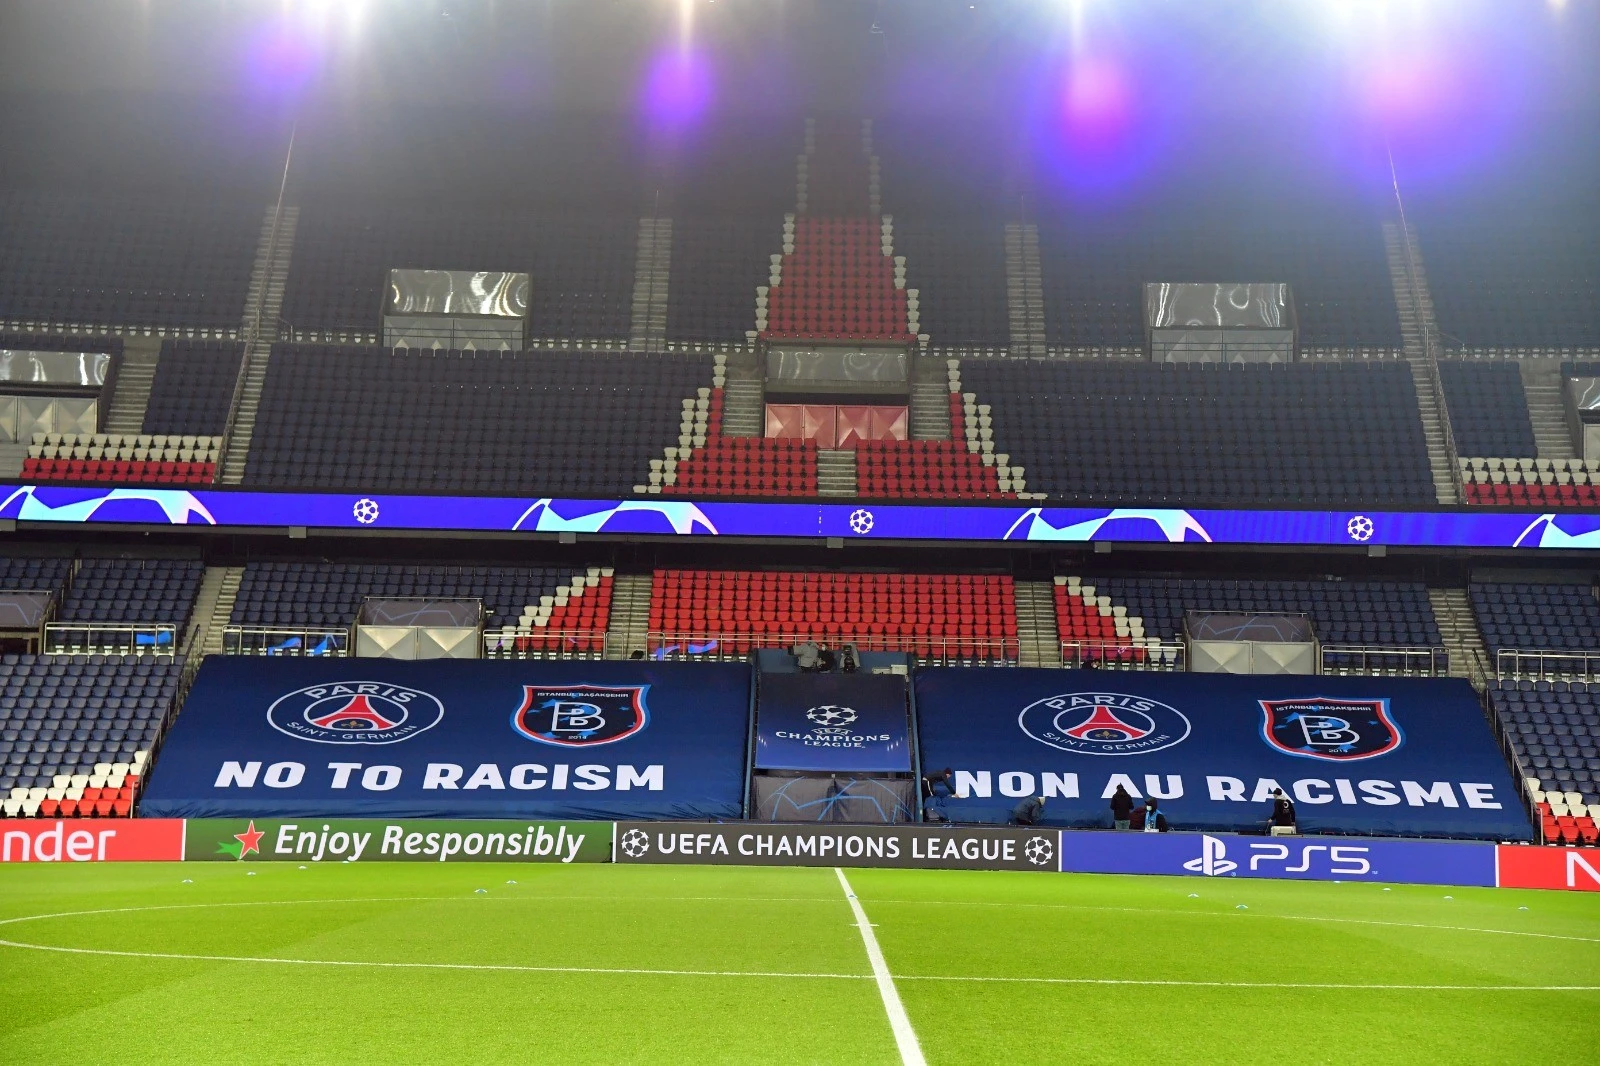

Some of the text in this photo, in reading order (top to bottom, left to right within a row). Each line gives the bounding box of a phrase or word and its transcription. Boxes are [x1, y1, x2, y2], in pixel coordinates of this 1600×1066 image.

[304, 684, 418, 703] PARIS
[1045, 695, 1155, 712] PARIS
[287, 721, 329, 737] SAINT
[342, 724, 418, 740] GERMAIN
[775, 731, 891, 742] CHAMPIONS
[1043, 732, 1088, 748] SAINT
[1102, 734, 1171, 751] GERMAIN
[804, 740, 862, 748] LEAGUE
[214, 761, 664, 791] NO TO RACISM
[955, 770, 1503, 810] NON AU RACISME
[3, 821, 117, 861] nder
[275, 824, 585, 863] Enjoy Responsibly
[657, 833, 1016, 861] UEFA CHAMPIONS LEAGUE
[1250, 843, 1371, 875] PS5
